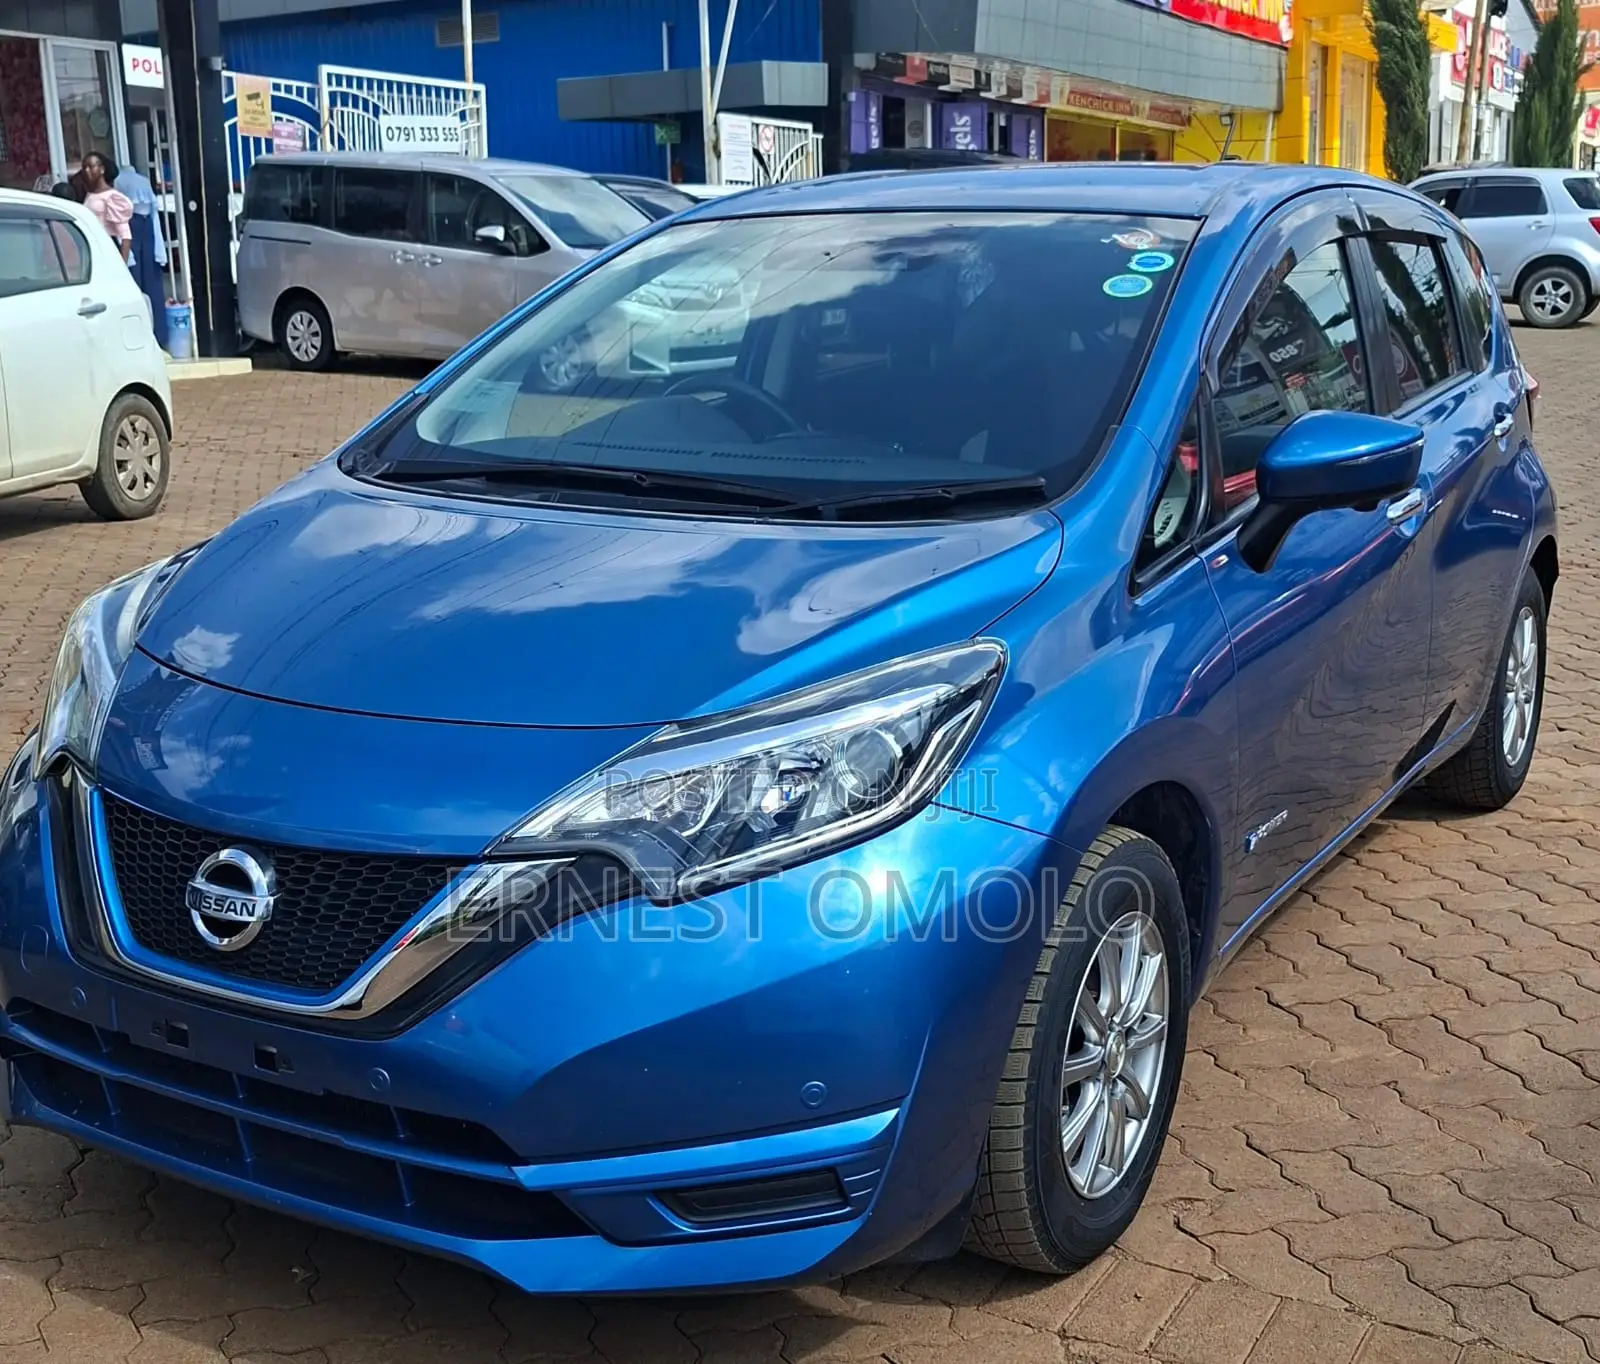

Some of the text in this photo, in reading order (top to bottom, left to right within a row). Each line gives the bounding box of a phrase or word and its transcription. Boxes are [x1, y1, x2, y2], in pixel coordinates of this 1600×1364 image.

[386, 126, 460, 142] 0791 333 555
[187, 886, 257, 918] NISSAN
